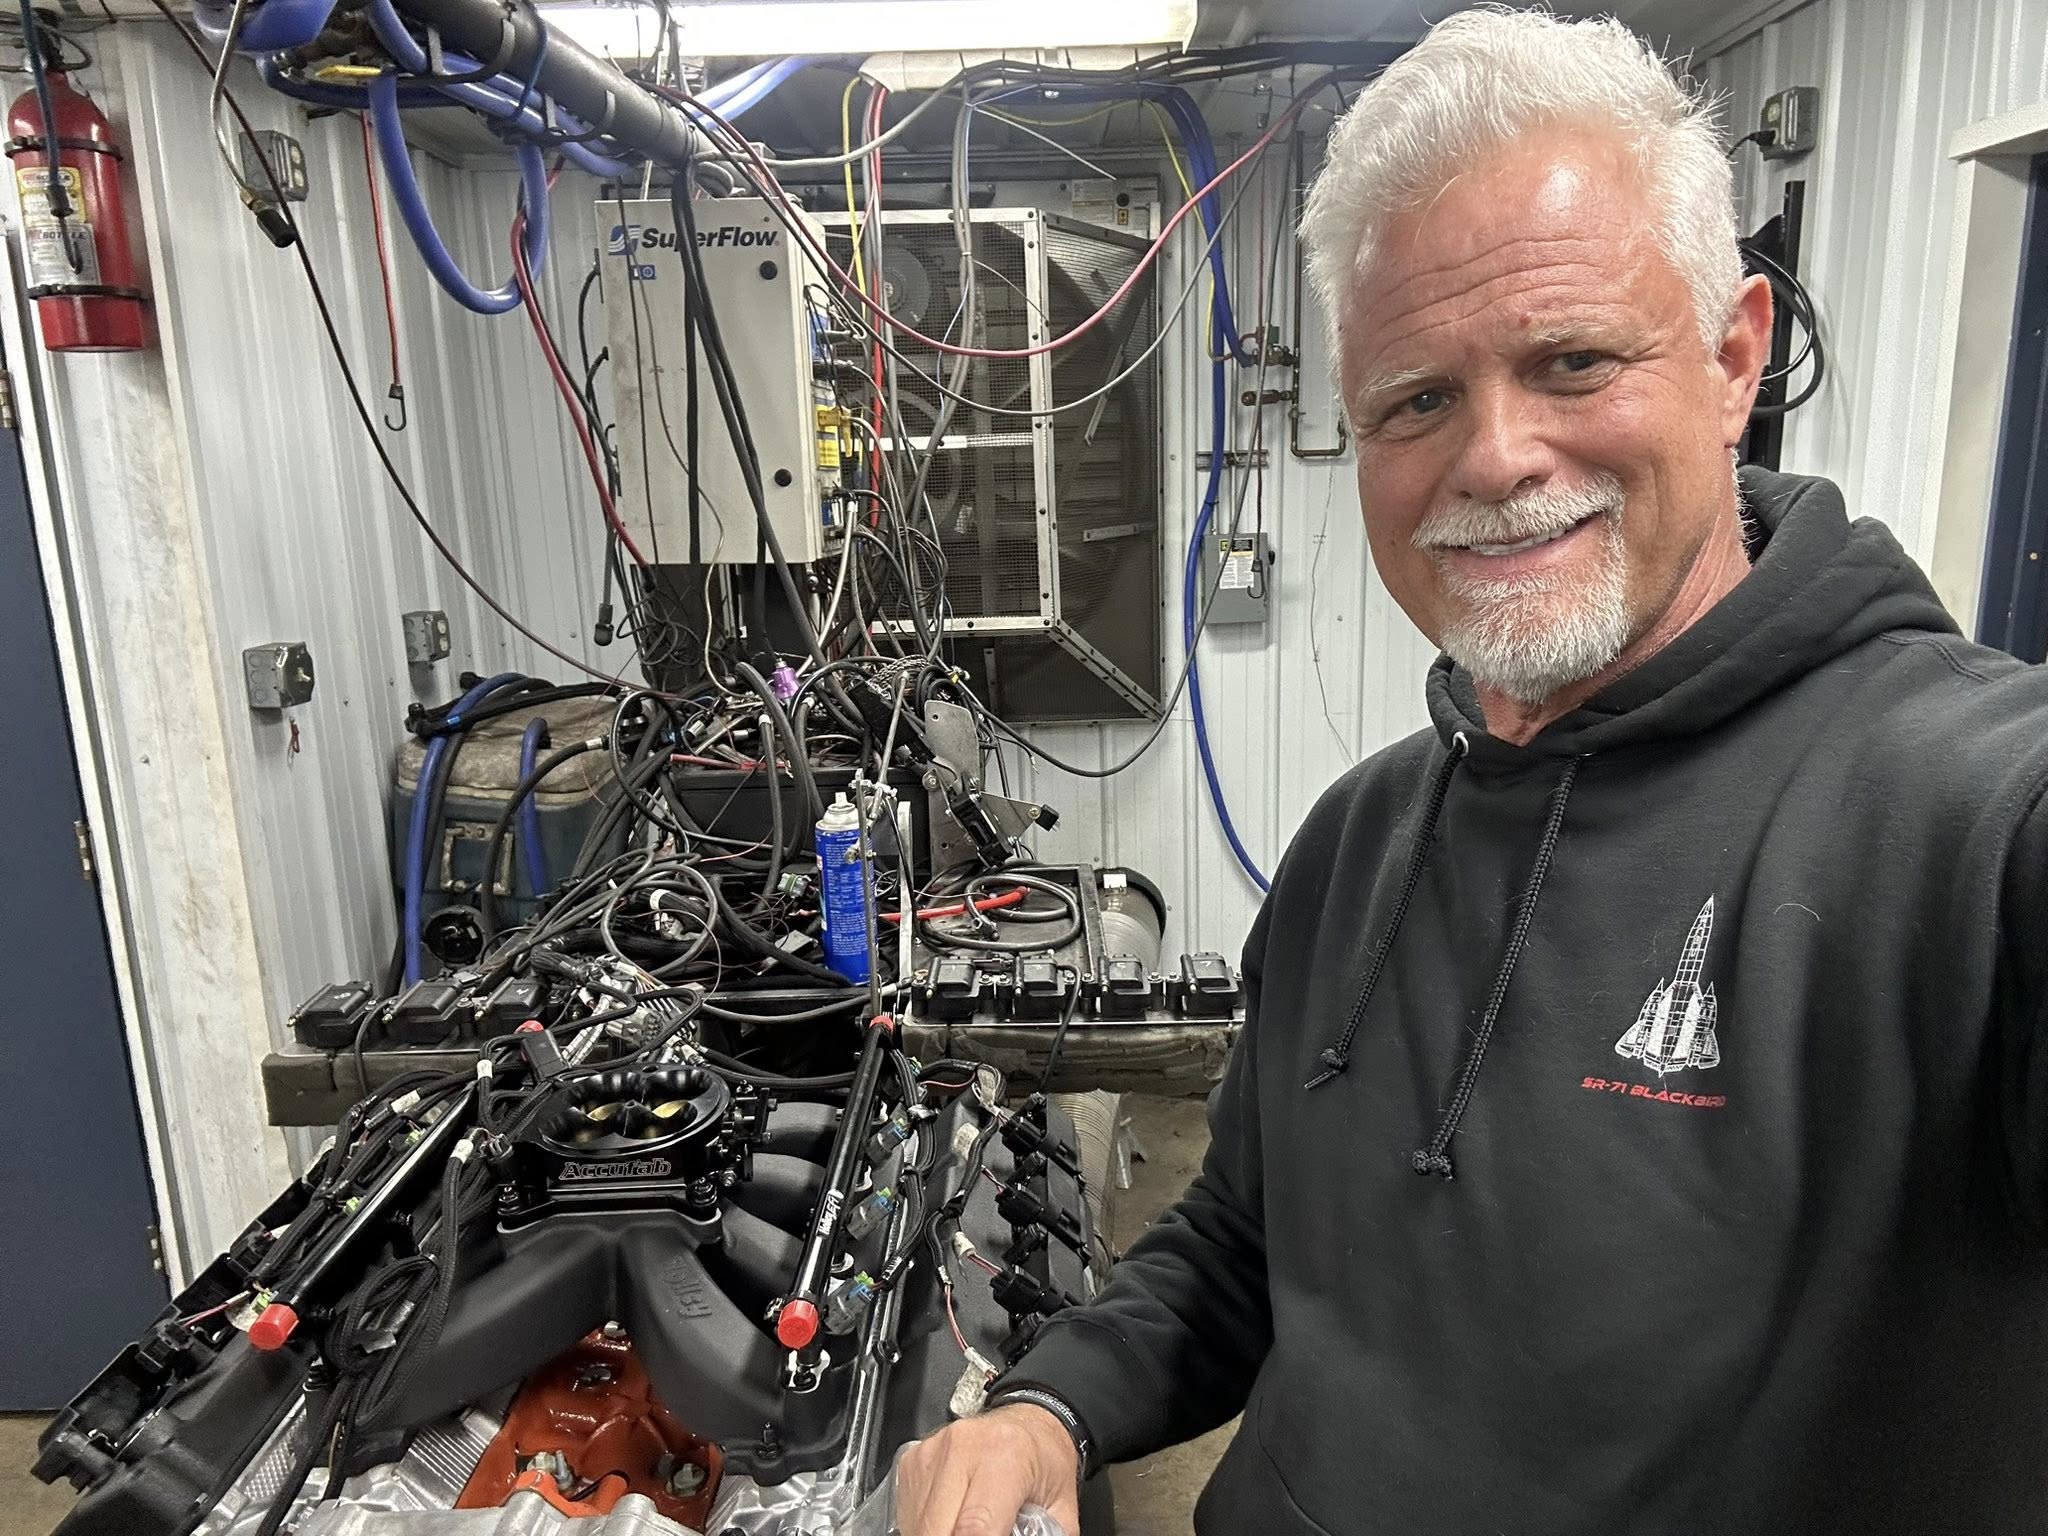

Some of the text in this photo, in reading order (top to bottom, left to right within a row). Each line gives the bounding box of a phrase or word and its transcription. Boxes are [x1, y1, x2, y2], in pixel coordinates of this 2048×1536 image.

[641, 227, 777, 252] SuerFlow
[1581, 1076, 1628, 1094] SR-71
[558, 1158, 672, 1180] Accufab
